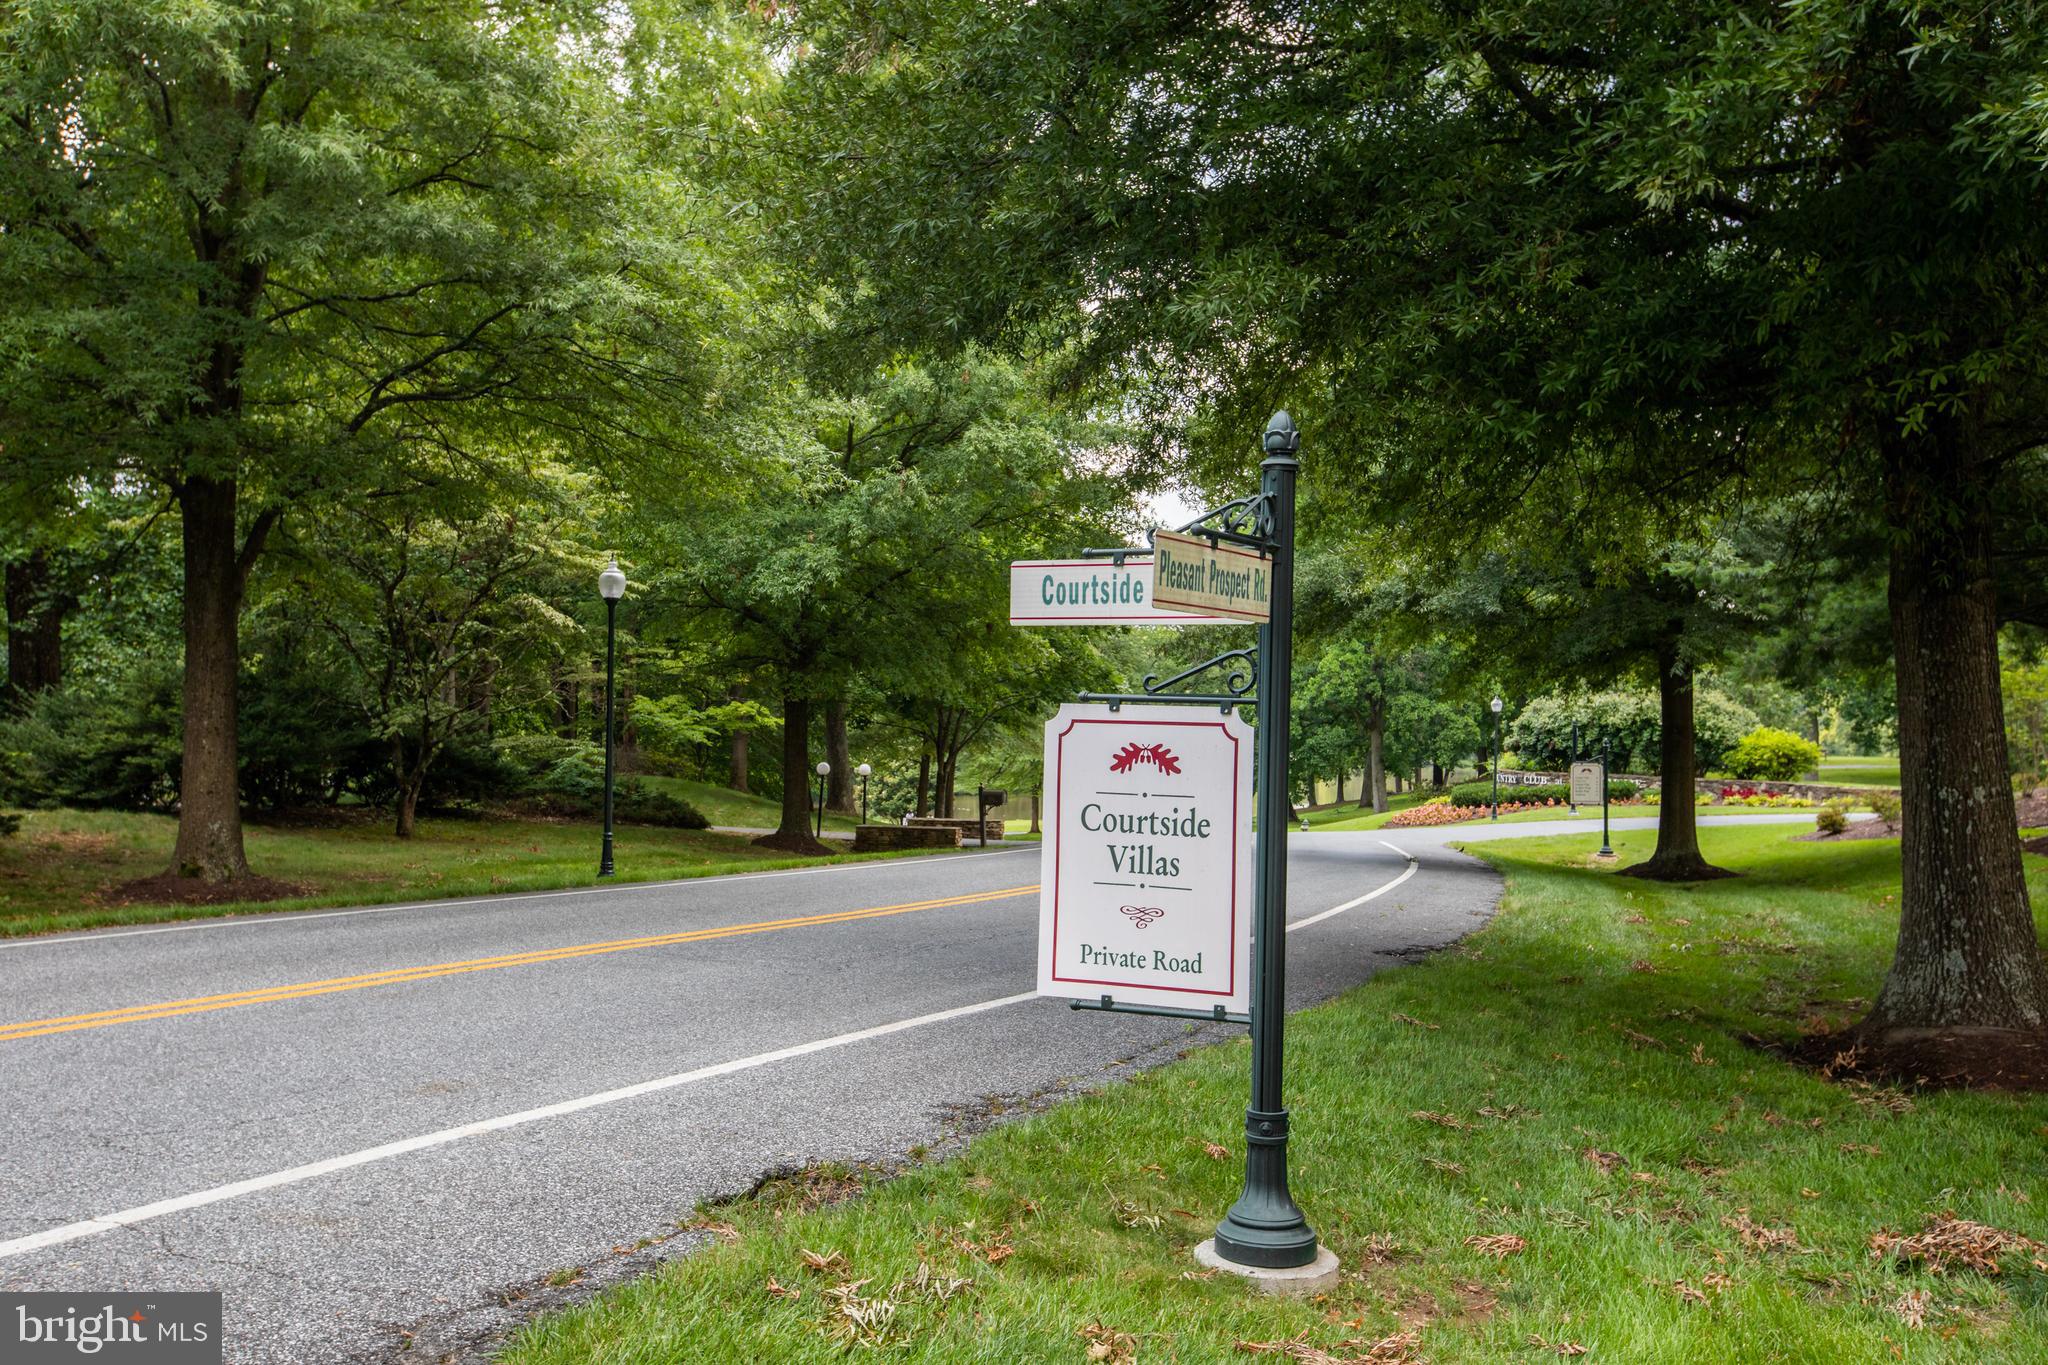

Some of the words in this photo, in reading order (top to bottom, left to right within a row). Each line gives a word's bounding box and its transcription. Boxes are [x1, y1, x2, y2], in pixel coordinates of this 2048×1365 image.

[1041, 573, 1144, 606] Courtside
[1159, 549, 1206, 593] Pleasant
[1209, 558, 1251, 605] Prospect
[1253, 568, 1268, 603] Rd.
[1080, 803, 1211, 839] Courtside
[1107, 844, 1180, 877] Villas
[1080, 943, 1146, 969] Private
[1152, 950, 1203, 974] Road
